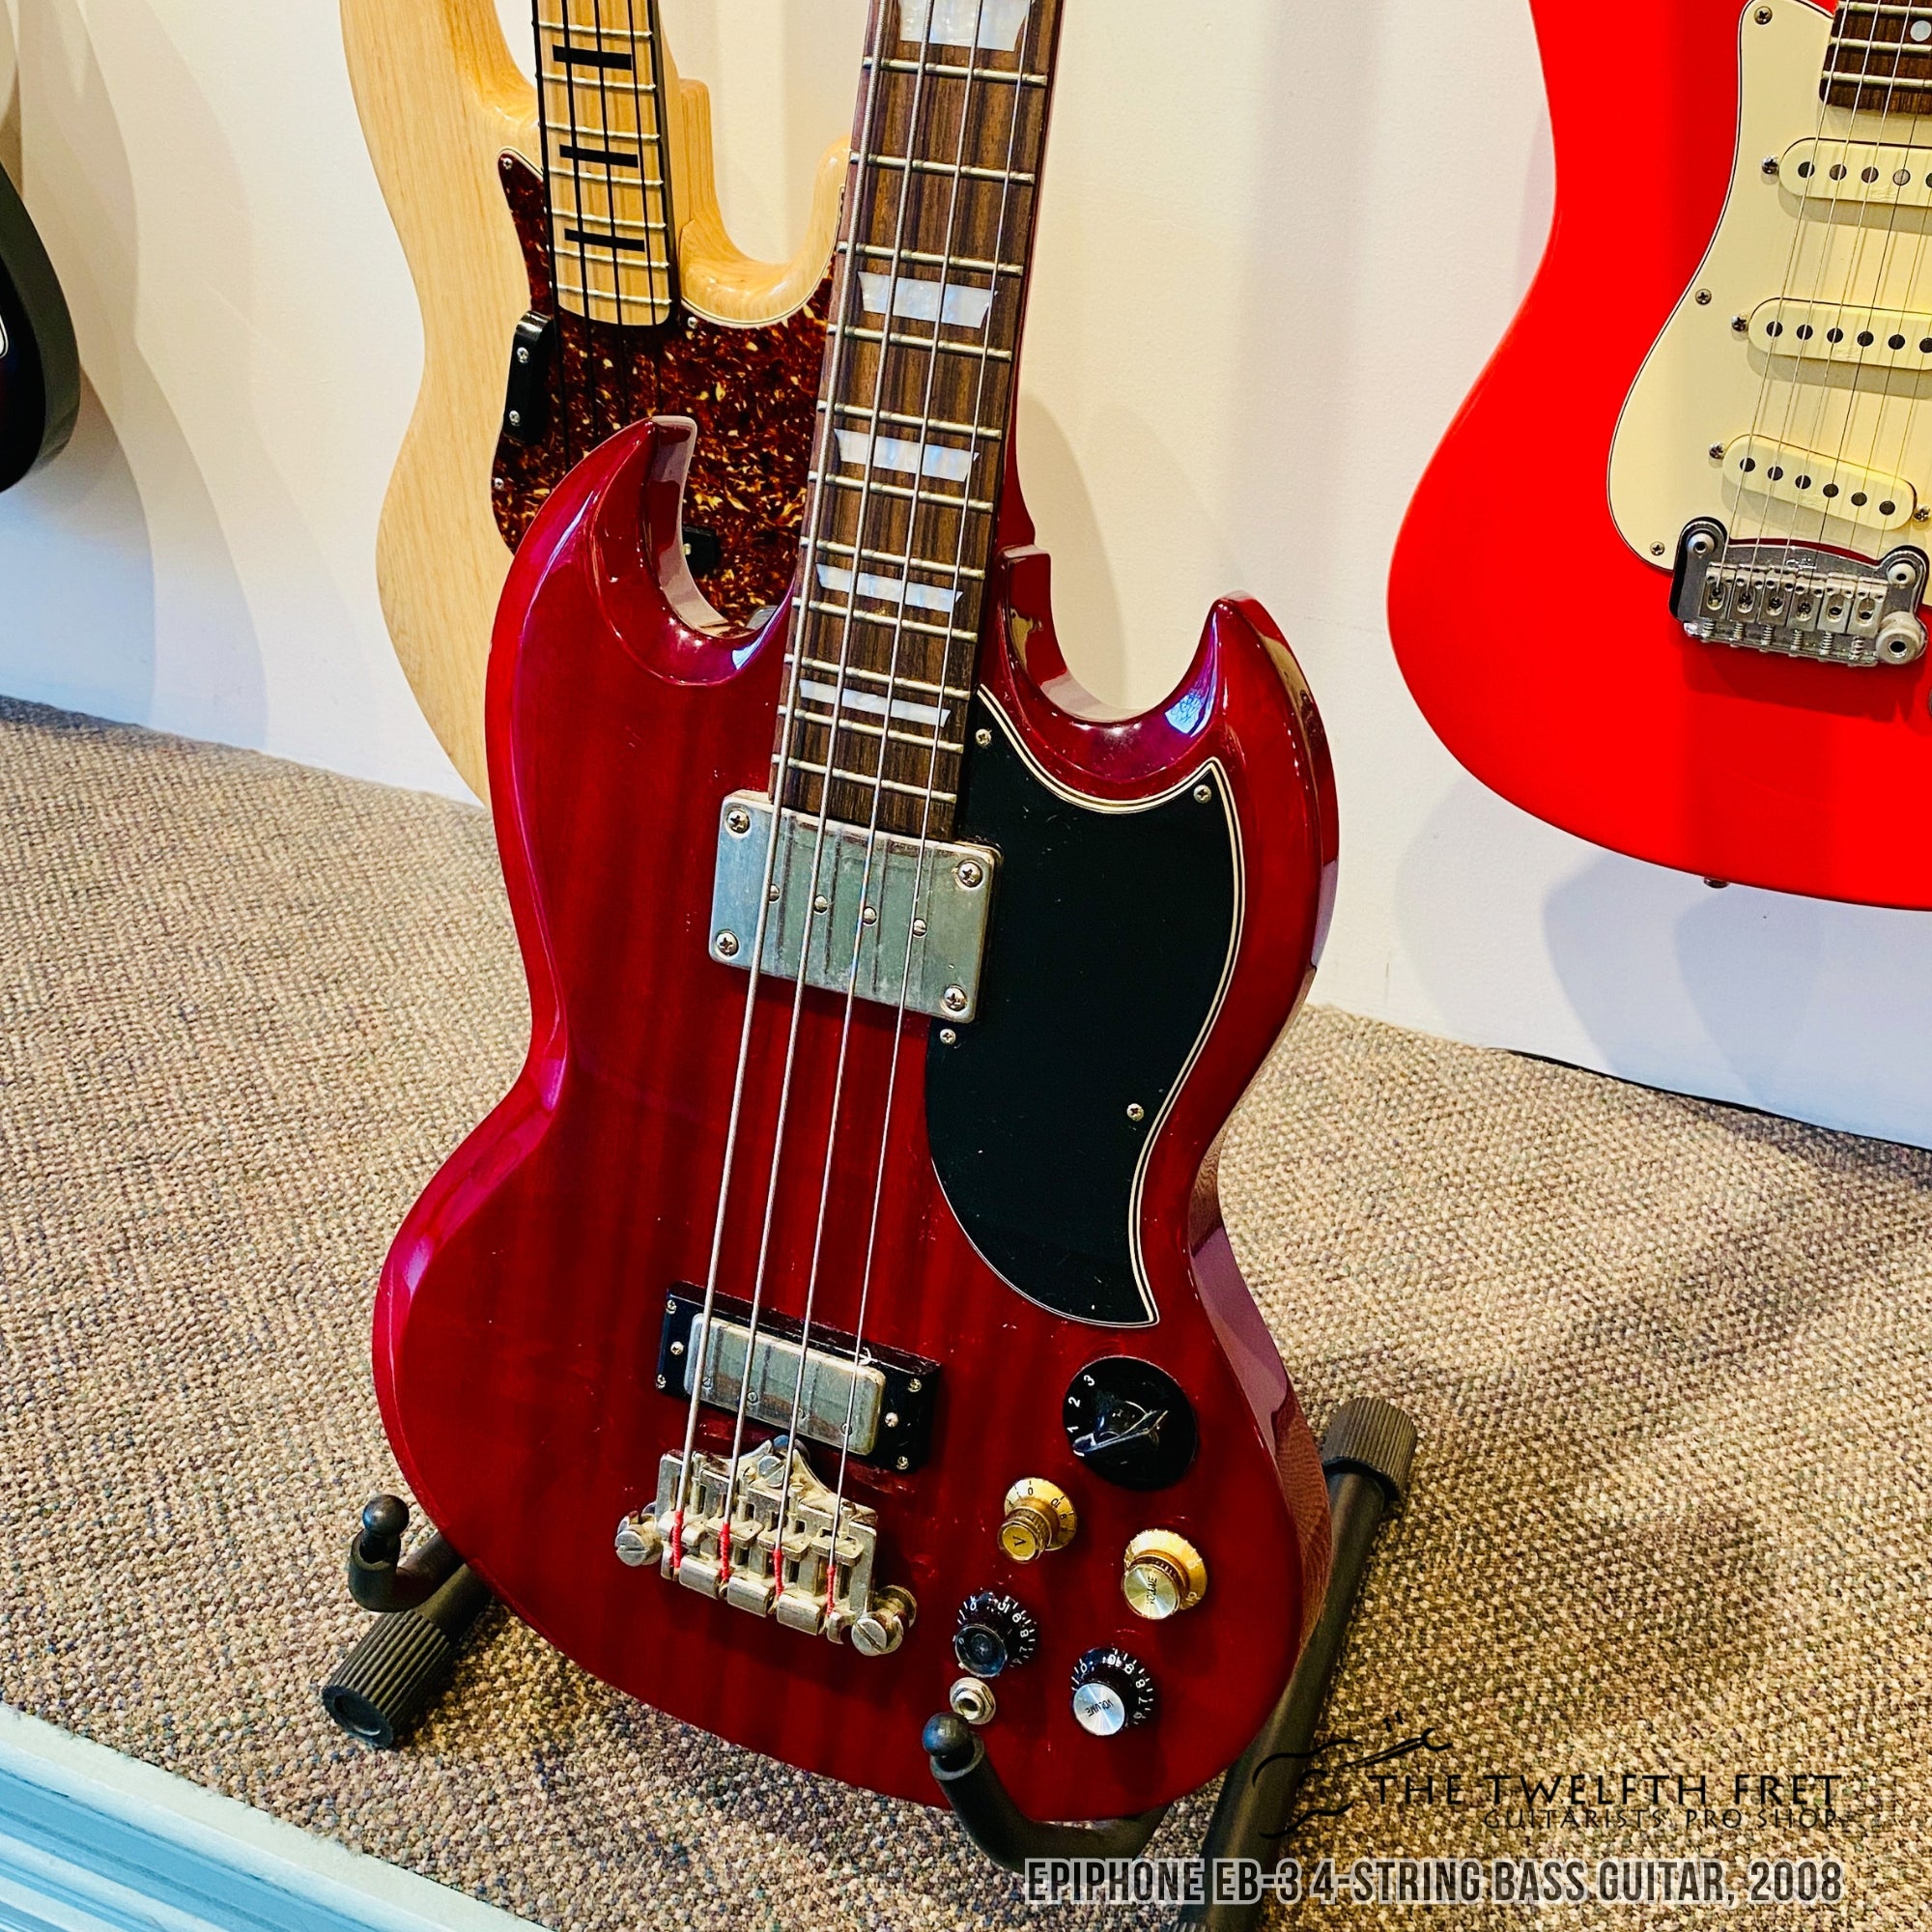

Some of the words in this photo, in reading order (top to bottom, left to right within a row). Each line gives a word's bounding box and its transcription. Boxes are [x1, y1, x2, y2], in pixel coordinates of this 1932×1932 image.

[1067, 1396, 1081, 1407] 2
[1083, 1375, 1095, 1387] 3
[1084, 1698, 1115, 1718] VOLUME
